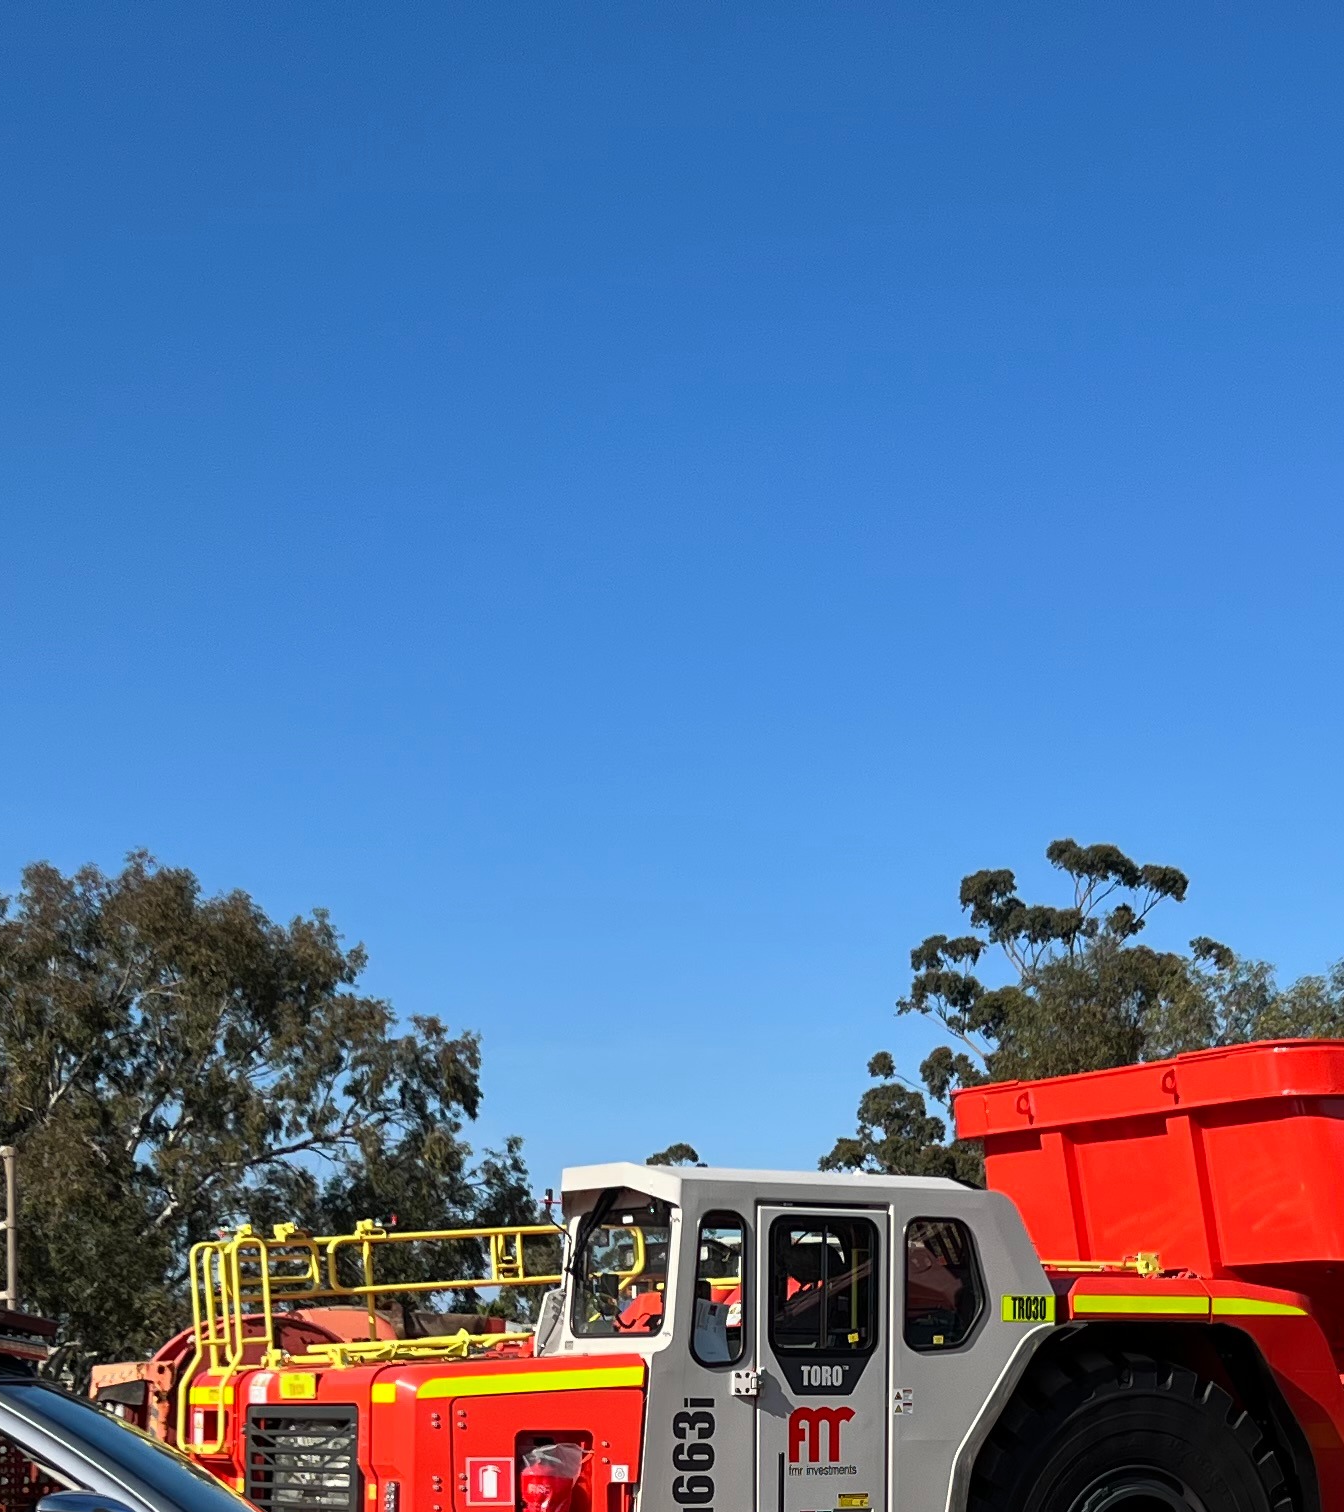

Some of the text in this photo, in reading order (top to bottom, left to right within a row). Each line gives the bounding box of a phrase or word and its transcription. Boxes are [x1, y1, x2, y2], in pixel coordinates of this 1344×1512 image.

[1012, 1295, 1047, 1321] TR030
[788, 1464, 857, 1476] fmr investments
